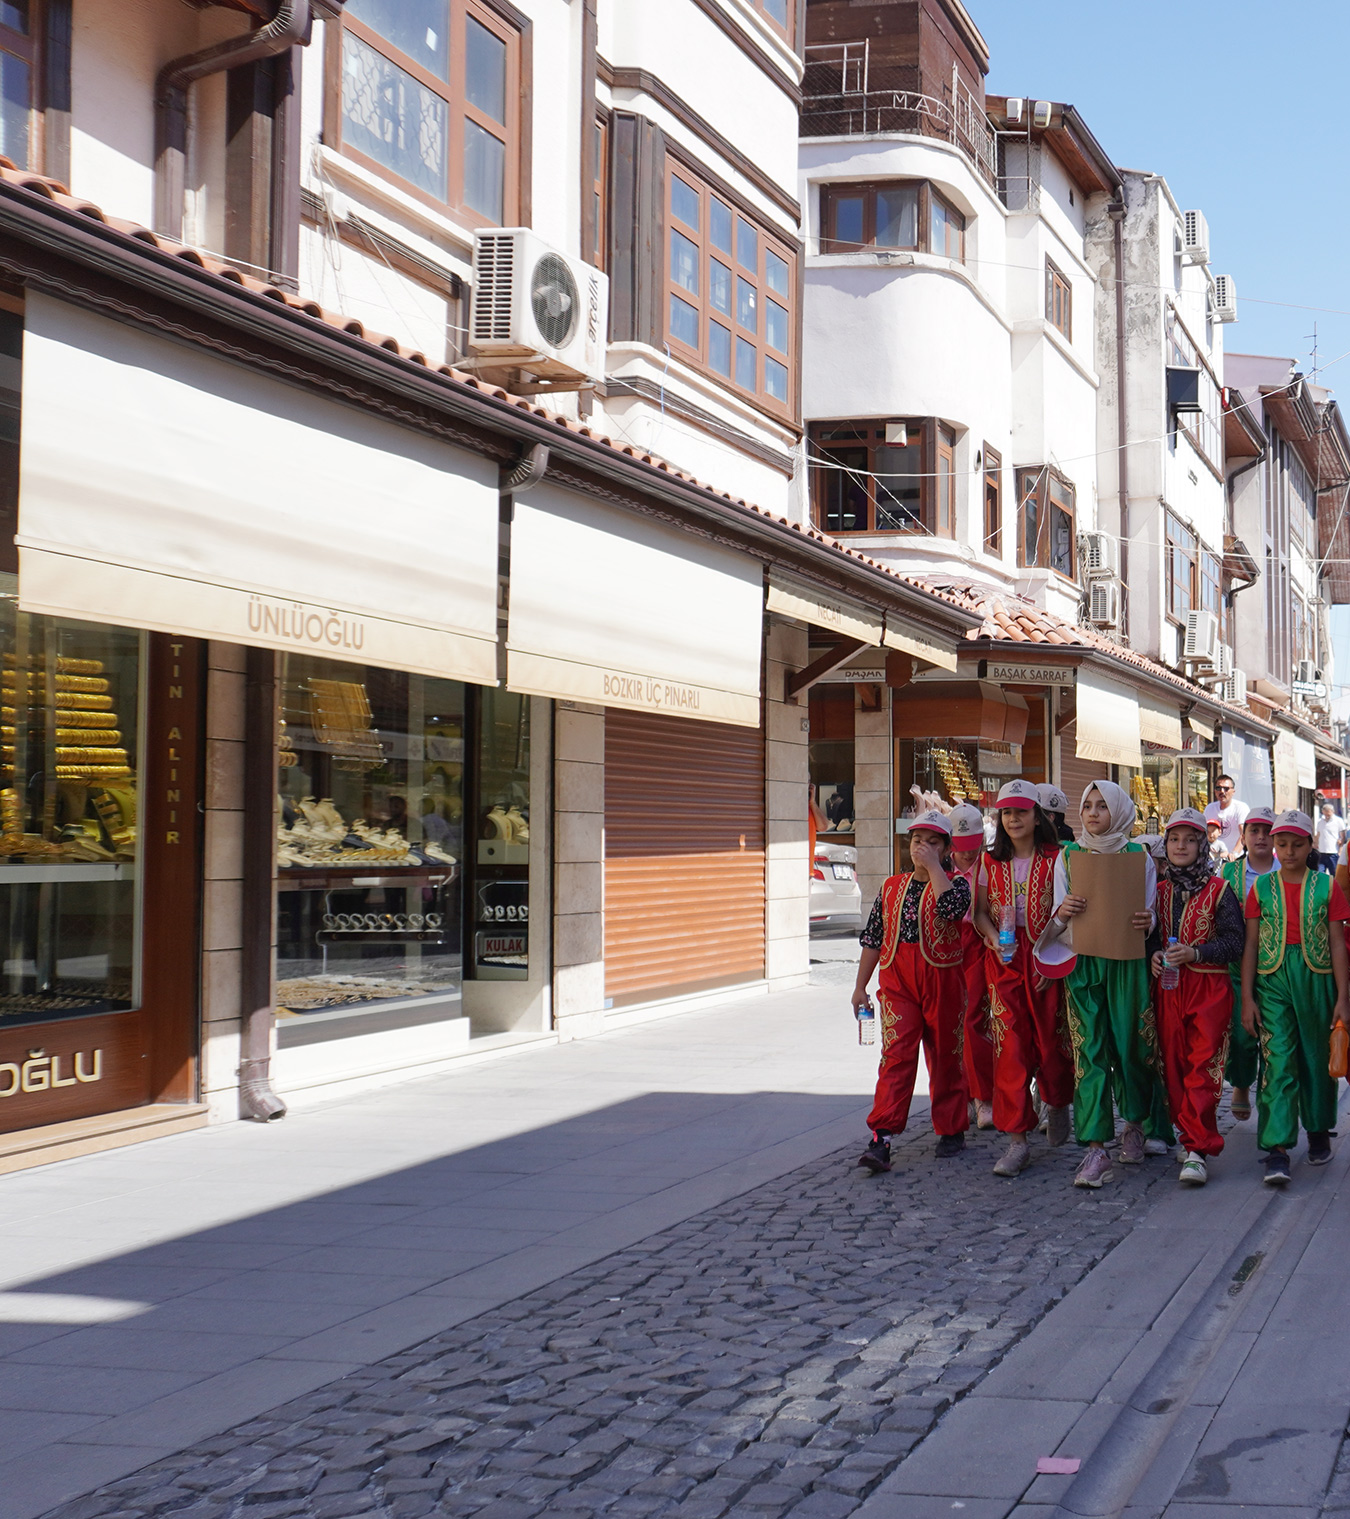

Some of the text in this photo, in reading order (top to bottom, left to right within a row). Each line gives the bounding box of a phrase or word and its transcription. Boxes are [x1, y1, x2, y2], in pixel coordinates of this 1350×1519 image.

[248, 595, 364, 650] ÜNLÜOĞLU
[817, 601, 842, 625] NECATİ
[993, 667, 1067, 682] BAŞAK SARRAF
[603, 674, 700, 710] BOZKIR ÜÇ PINARLI
[166, 726, 183, 845] ALINIR
[485, 938, 523, 952] KULAK
